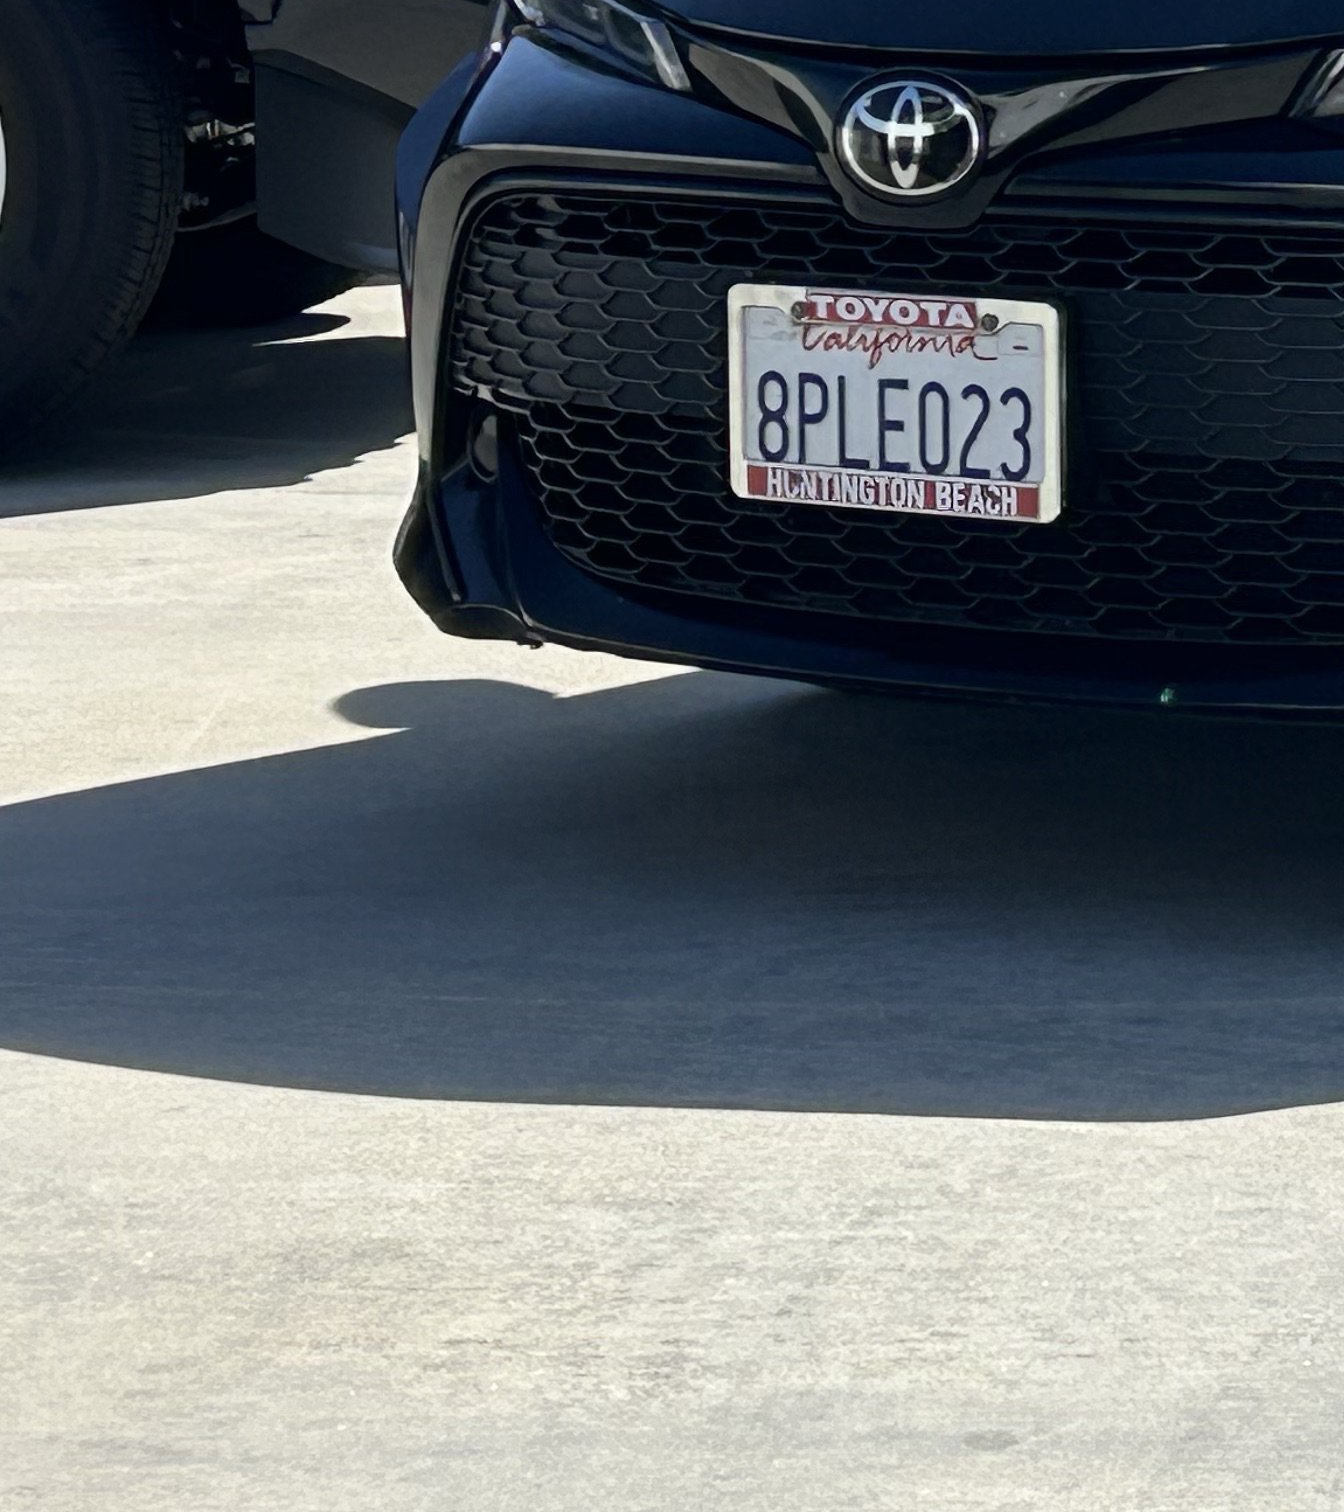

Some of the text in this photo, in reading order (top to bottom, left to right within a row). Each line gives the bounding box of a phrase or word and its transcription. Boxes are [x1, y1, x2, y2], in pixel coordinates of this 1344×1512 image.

[807, 294, 975, 329] TOYOTA
[802, 325, 998, 370] California
[757, 369, 1032, 482] 8PLE023
[766, 467, 1018, 517] HUNTINGTON BEACH
